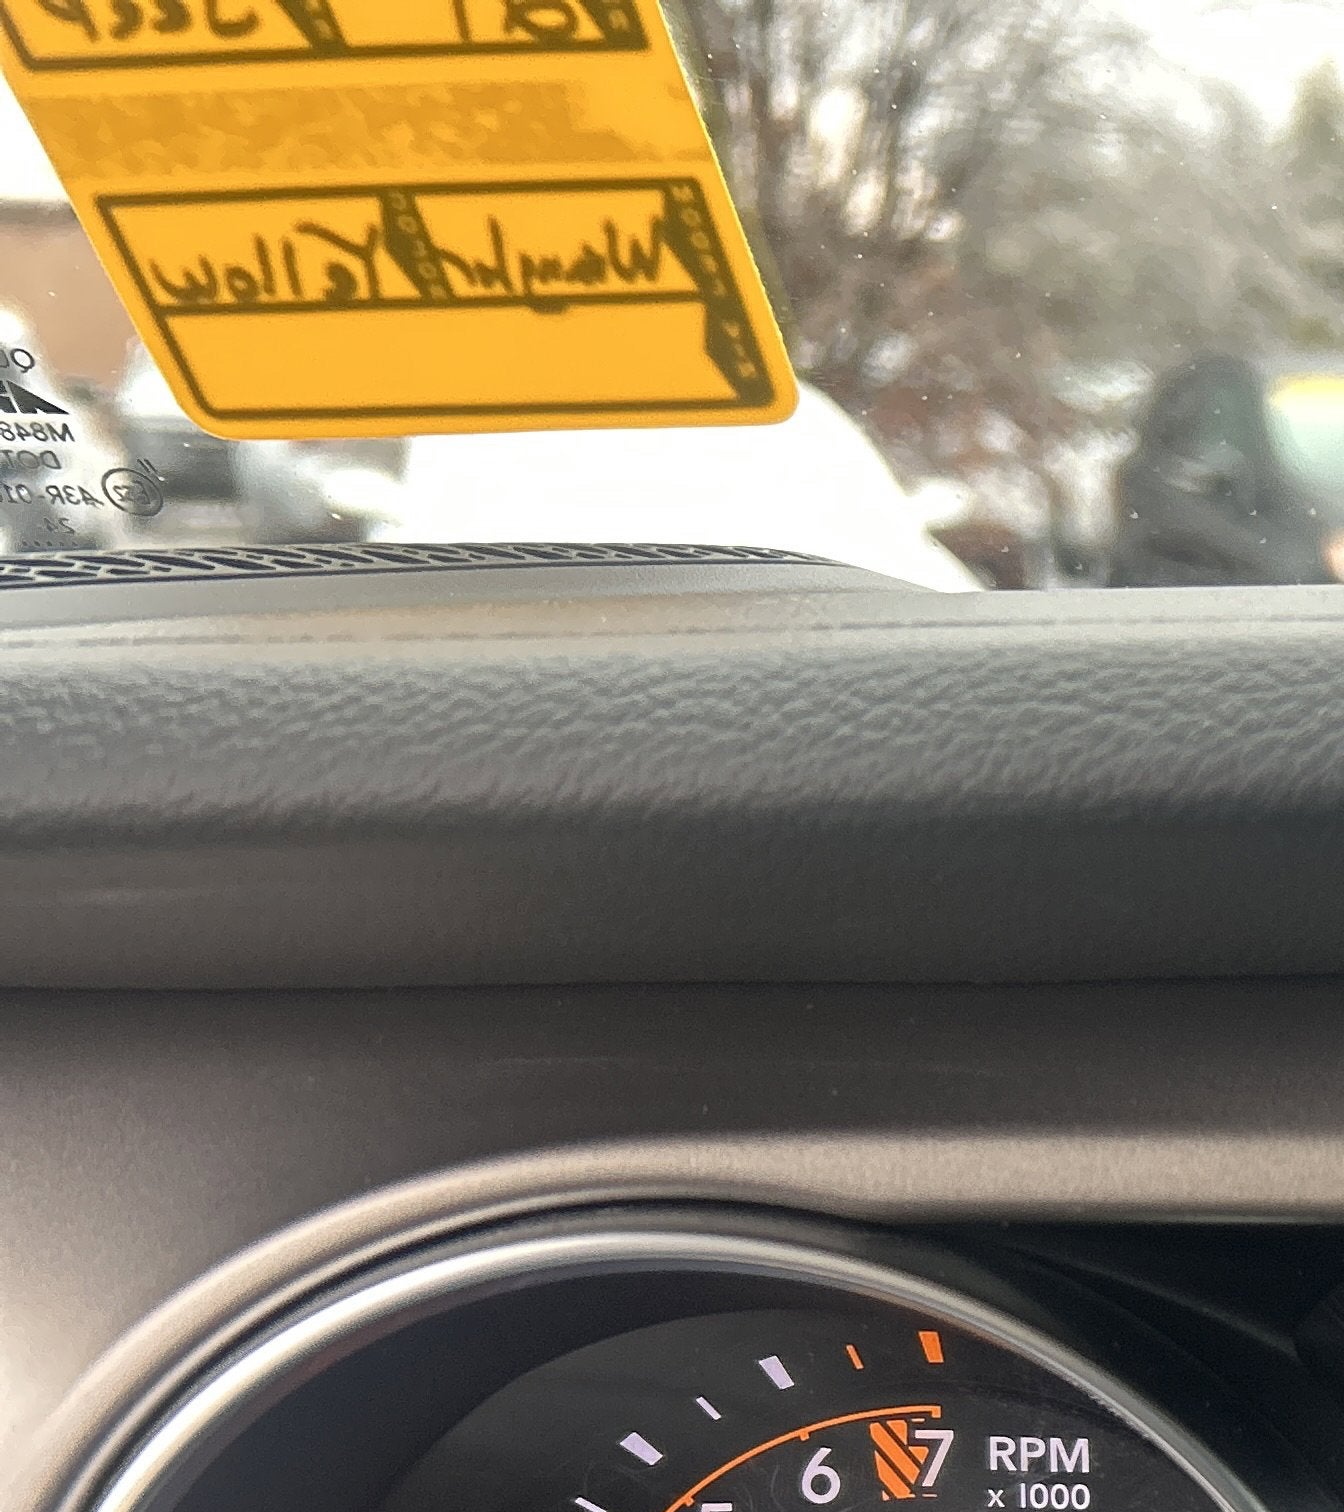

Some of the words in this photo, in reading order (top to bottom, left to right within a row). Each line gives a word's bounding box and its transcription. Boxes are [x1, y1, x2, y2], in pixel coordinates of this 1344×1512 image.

[801, 1447, 841, 1505] 6
[916, 1429, 954, 1487] 7
[989, 1436, 1090, 1474] RPM
[1019, 1482, 1091, 1510] 1000
